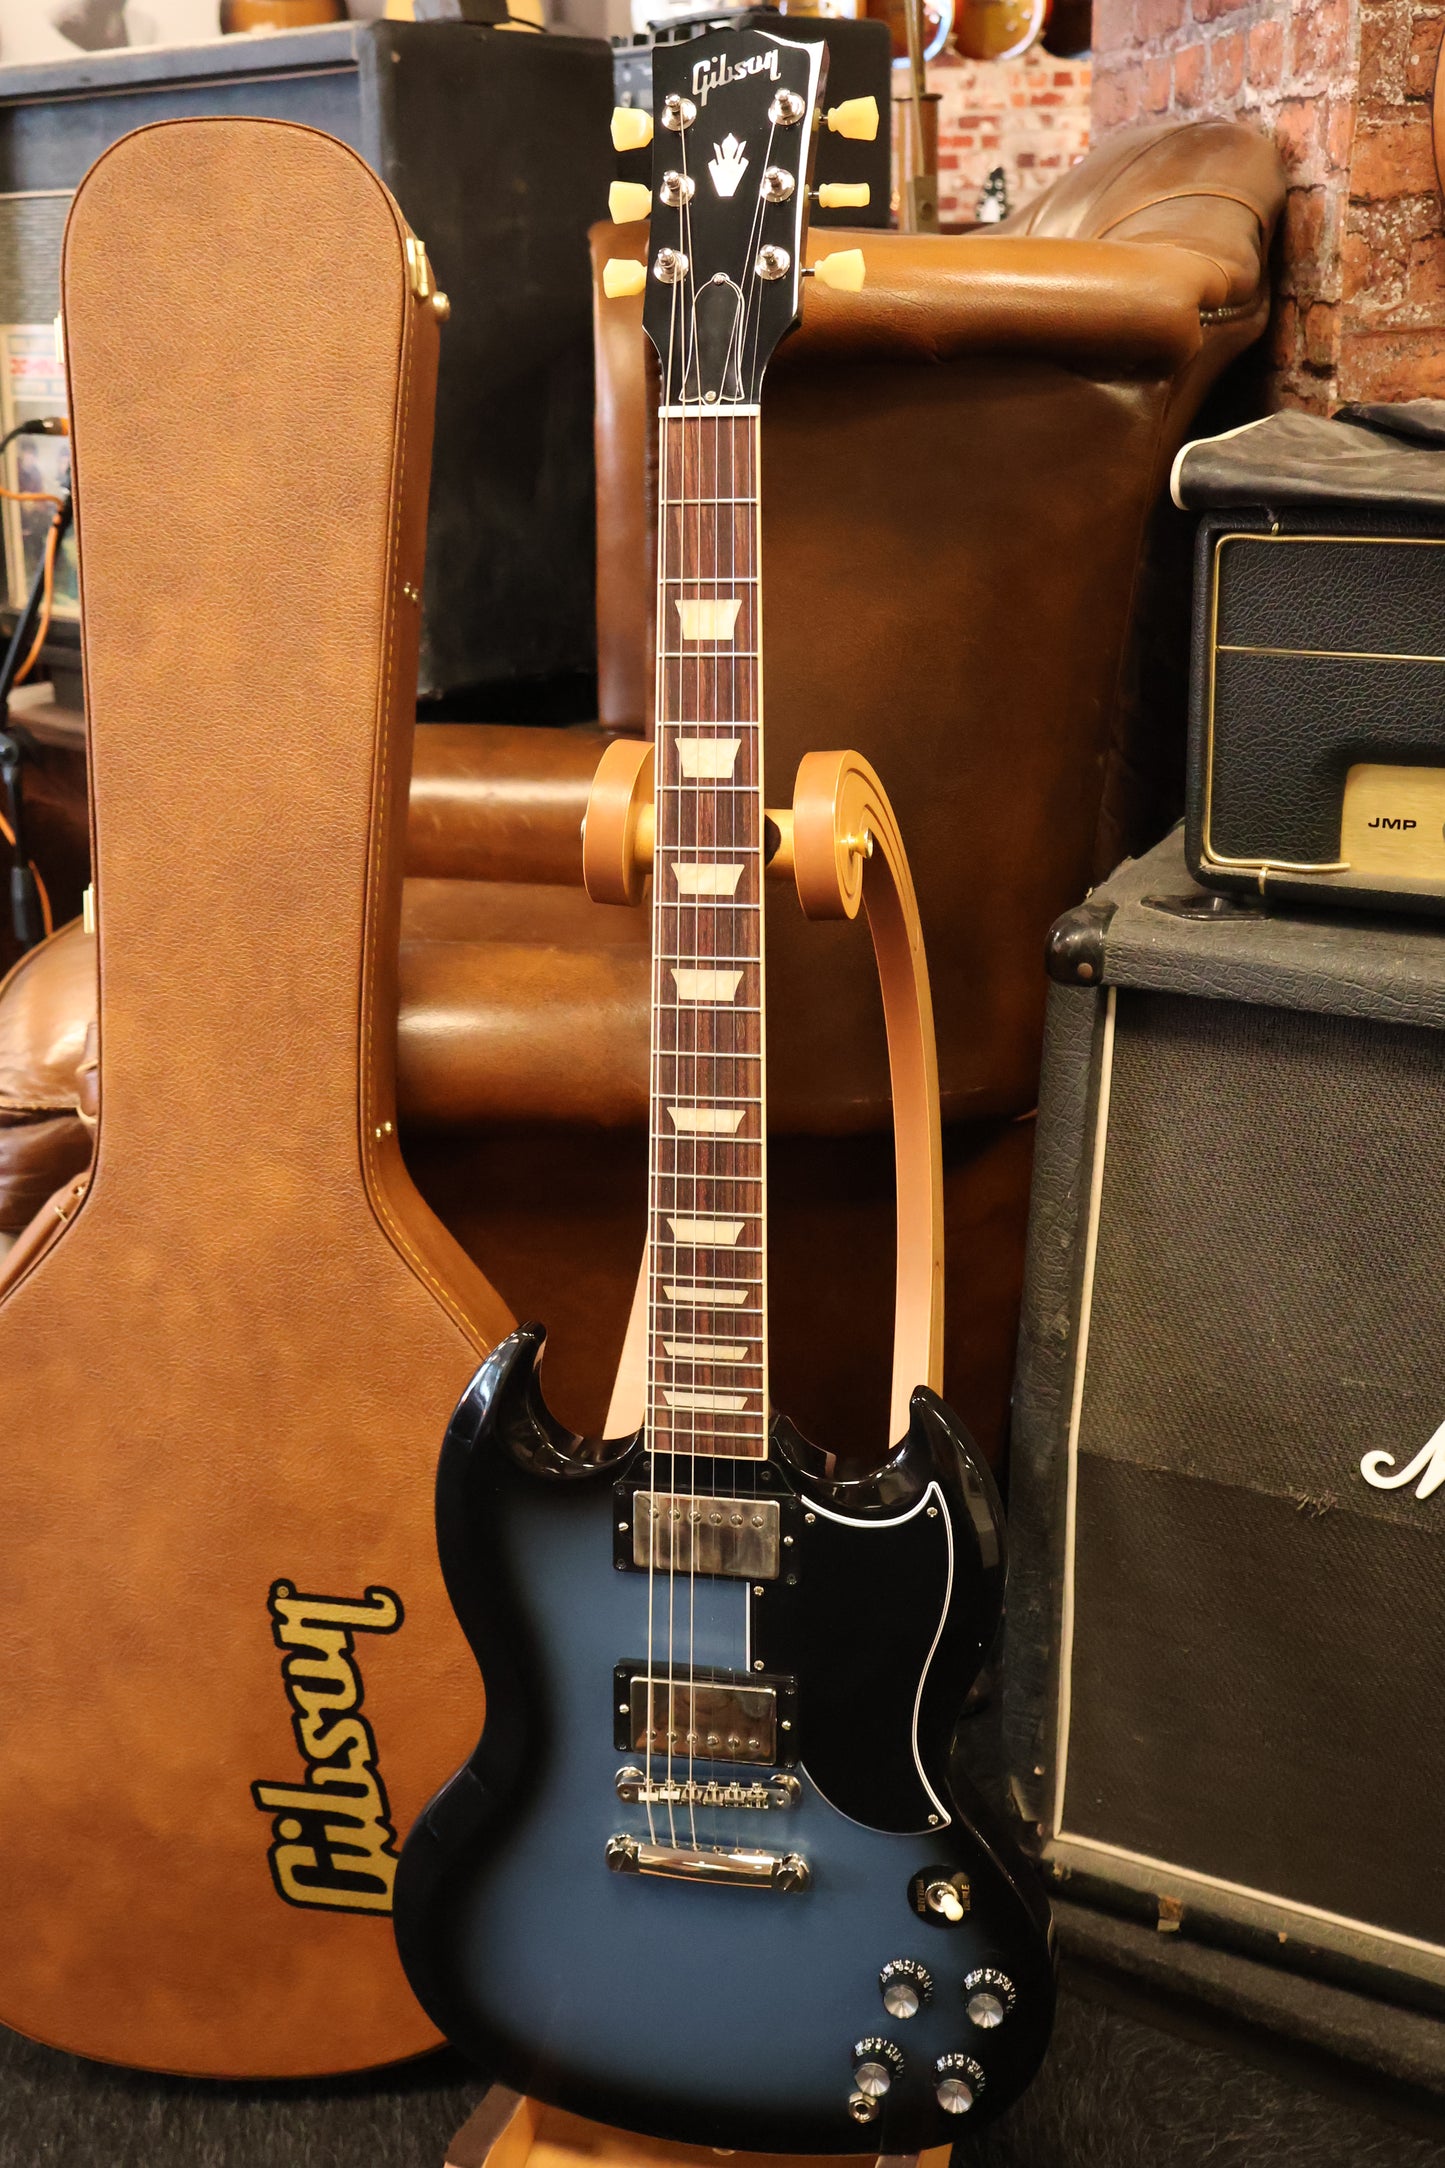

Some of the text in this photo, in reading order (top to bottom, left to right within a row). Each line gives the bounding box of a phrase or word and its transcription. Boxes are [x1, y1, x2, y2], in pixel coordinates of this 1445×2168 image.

[692, 49, 781, 107] Gibson
[1368, 817, 1417, 830] JMP
[250, 1578, 404, 1917] Gibson
